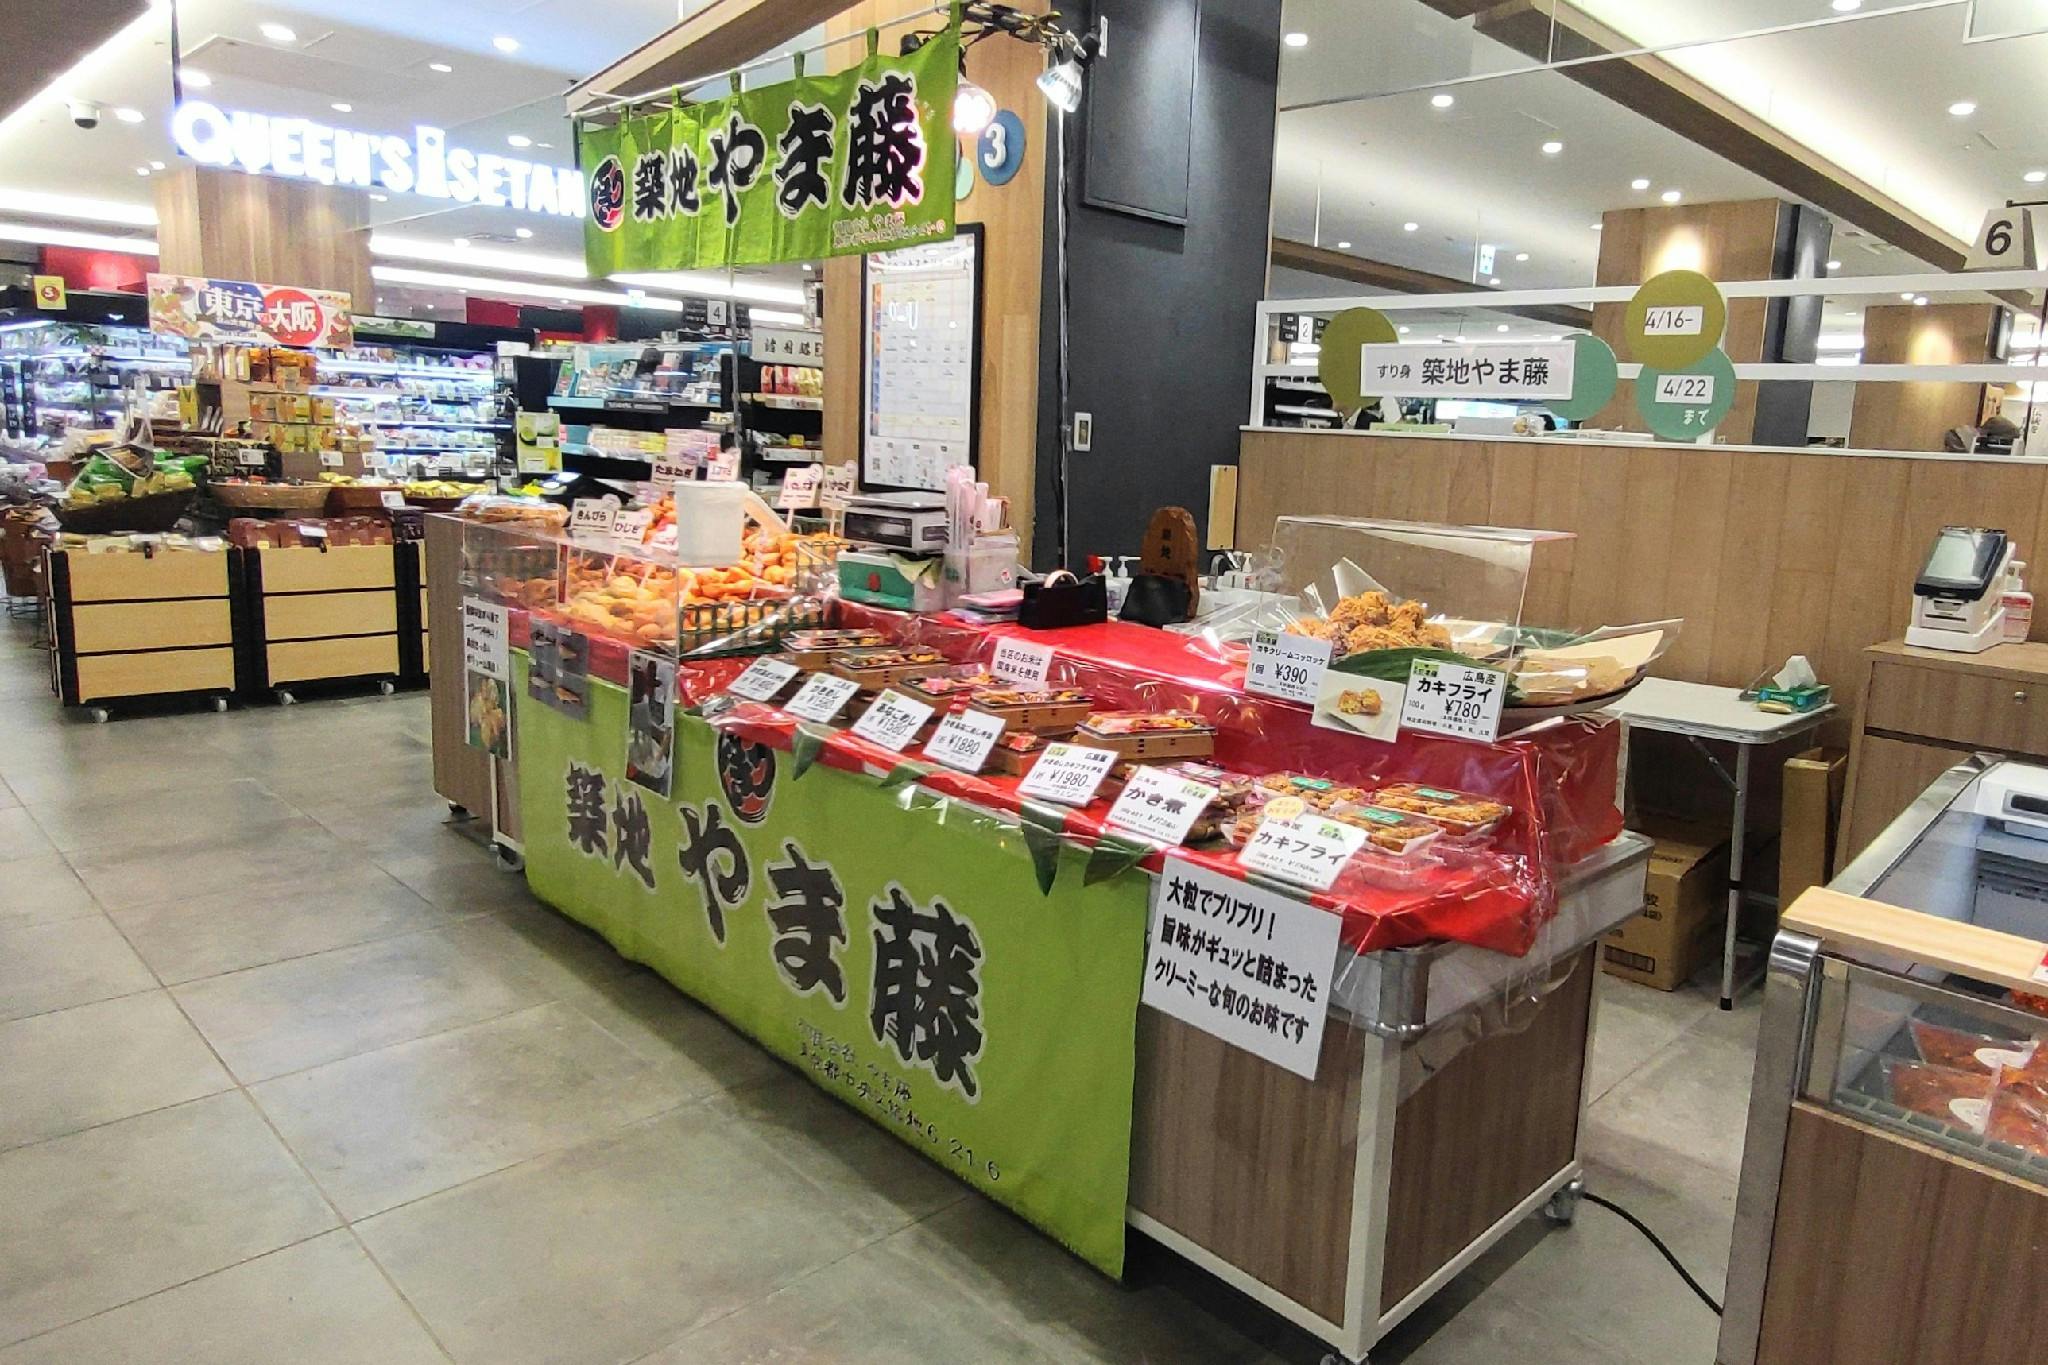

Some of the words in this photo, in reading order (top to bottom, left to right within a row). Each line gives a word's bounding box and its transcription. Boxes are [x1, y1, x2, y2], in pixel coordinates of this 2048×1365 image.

[984, 122, 1007, 168] 3
[171, 101, 414, 193] QUEEN'S
[415, 124, 587, 218] ISETAN
[1985, 219, 2013, 256] 6
[199, 287, 263, 320] 東京
[268, 300, 317, 333] 大阪
[713, 305, 721, 320] 4
[1302, 322, 1309, 338] 2
[1376, 363, 1412, 379] すり身
[1421, 357, 1550, 386] 築地やま藤
[1663, 378, 1706, 397] 4/22
[1682, 409, 1710, 426] まで
[655, 464, 694, 479] たまねぎ
[576, 509, 607, 522] きんぴら
[614, 521, 641, 534] ひじき
[1275, 662, 1308, 685] ¥390
[1463, 670, 1497, 686] 広島産
[1417, 677, 1493, 703] カキフライ
[1124, 787, 1188, 815] かき煮
[1255, 831, 1347, 865] カキフライ
[1160, 913, 1318, 1003] 旨味がギュッと詰まった
[1154, 955, 1310, 1045] クリーミーな旬のお味です
